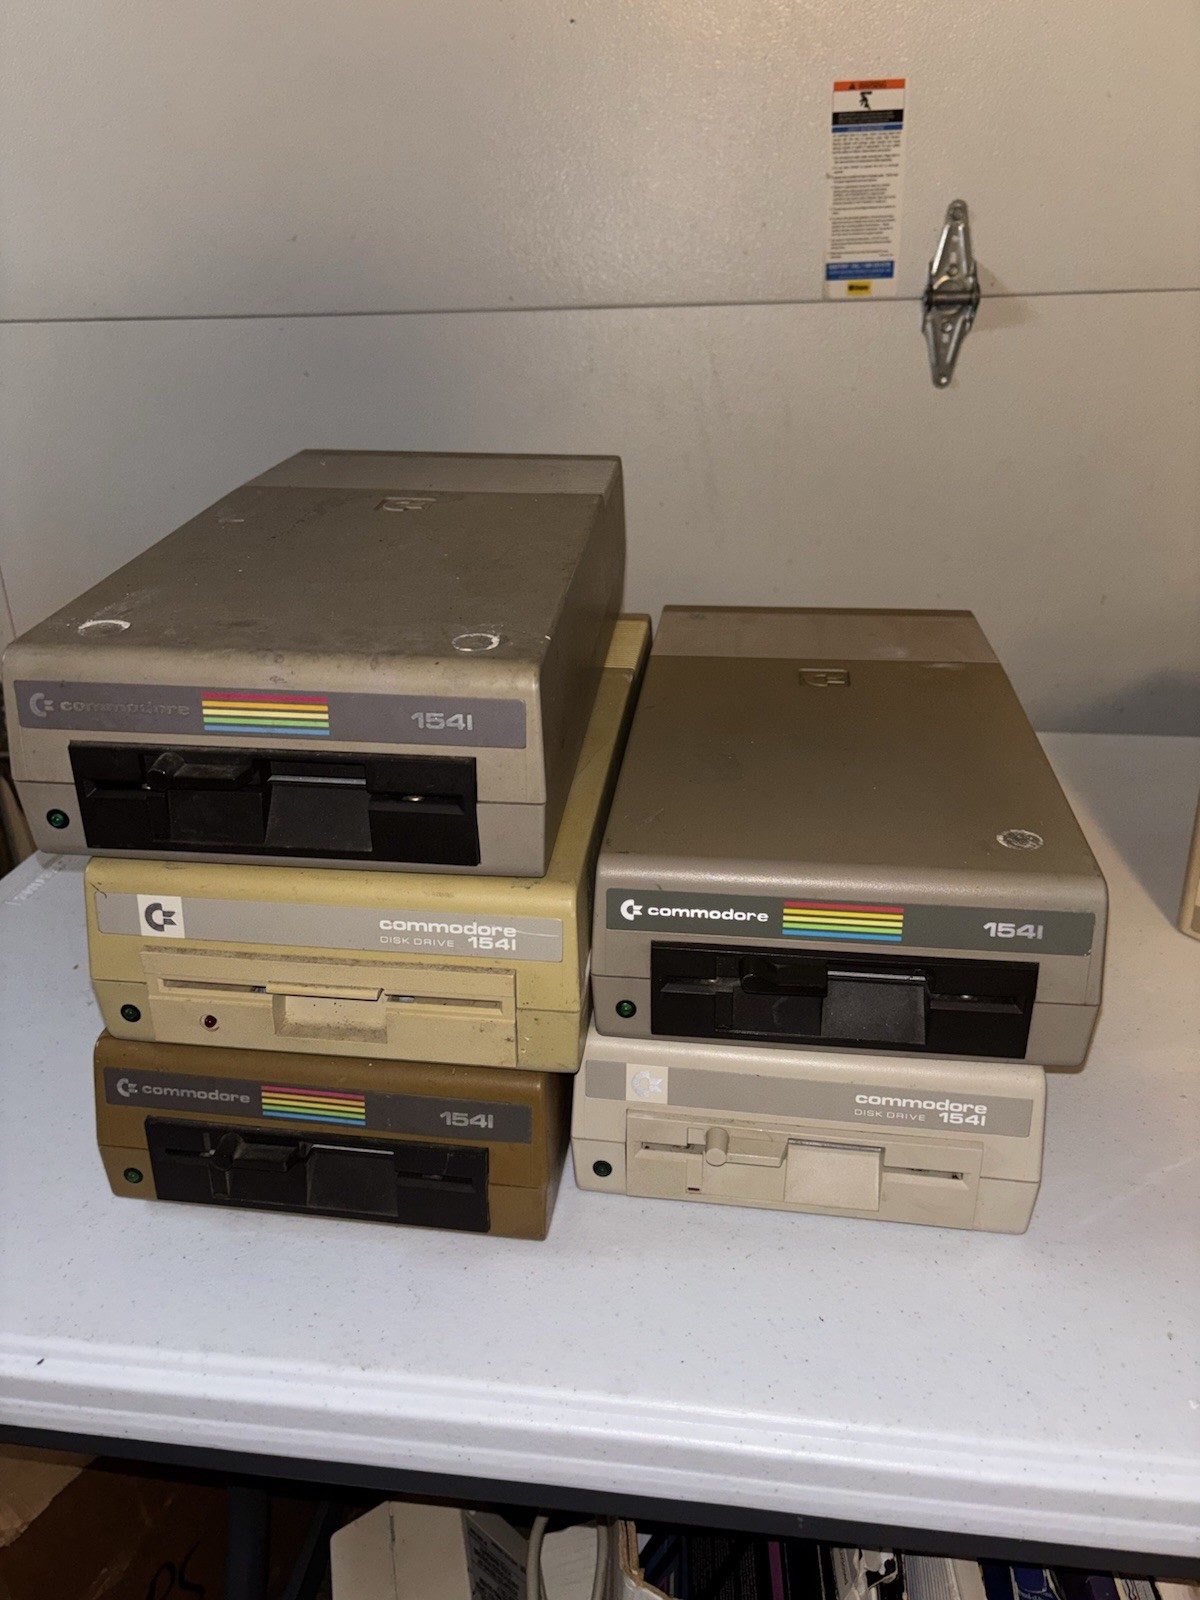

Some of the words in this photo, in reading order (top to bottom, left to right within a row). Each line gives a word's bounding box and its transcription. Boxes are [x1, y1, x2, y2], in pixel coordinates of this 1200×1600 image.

[60, 700, 190, 716] commodore
[411, 712, 473, 731] 1541
[379, 919, 517, 938] commodore
[647, 906, 769, 922] commodore
[983, 922, 1044, 940] 1541
[380, 936, 410, 945] DISK
[413, 938, 455, 948] DRIVE
[468, 936, 517, 951] 1541
[142, 1084, 251, 1103] commodore
[440, 1111, 494, 1129] 1541
[855, 1094, 988, 1114] commodore
[854, 1108, 883, 1118] DISK
[886, 1111, 926, 1122] DRIVE
[938, 1112, 986, 1127] 1541
